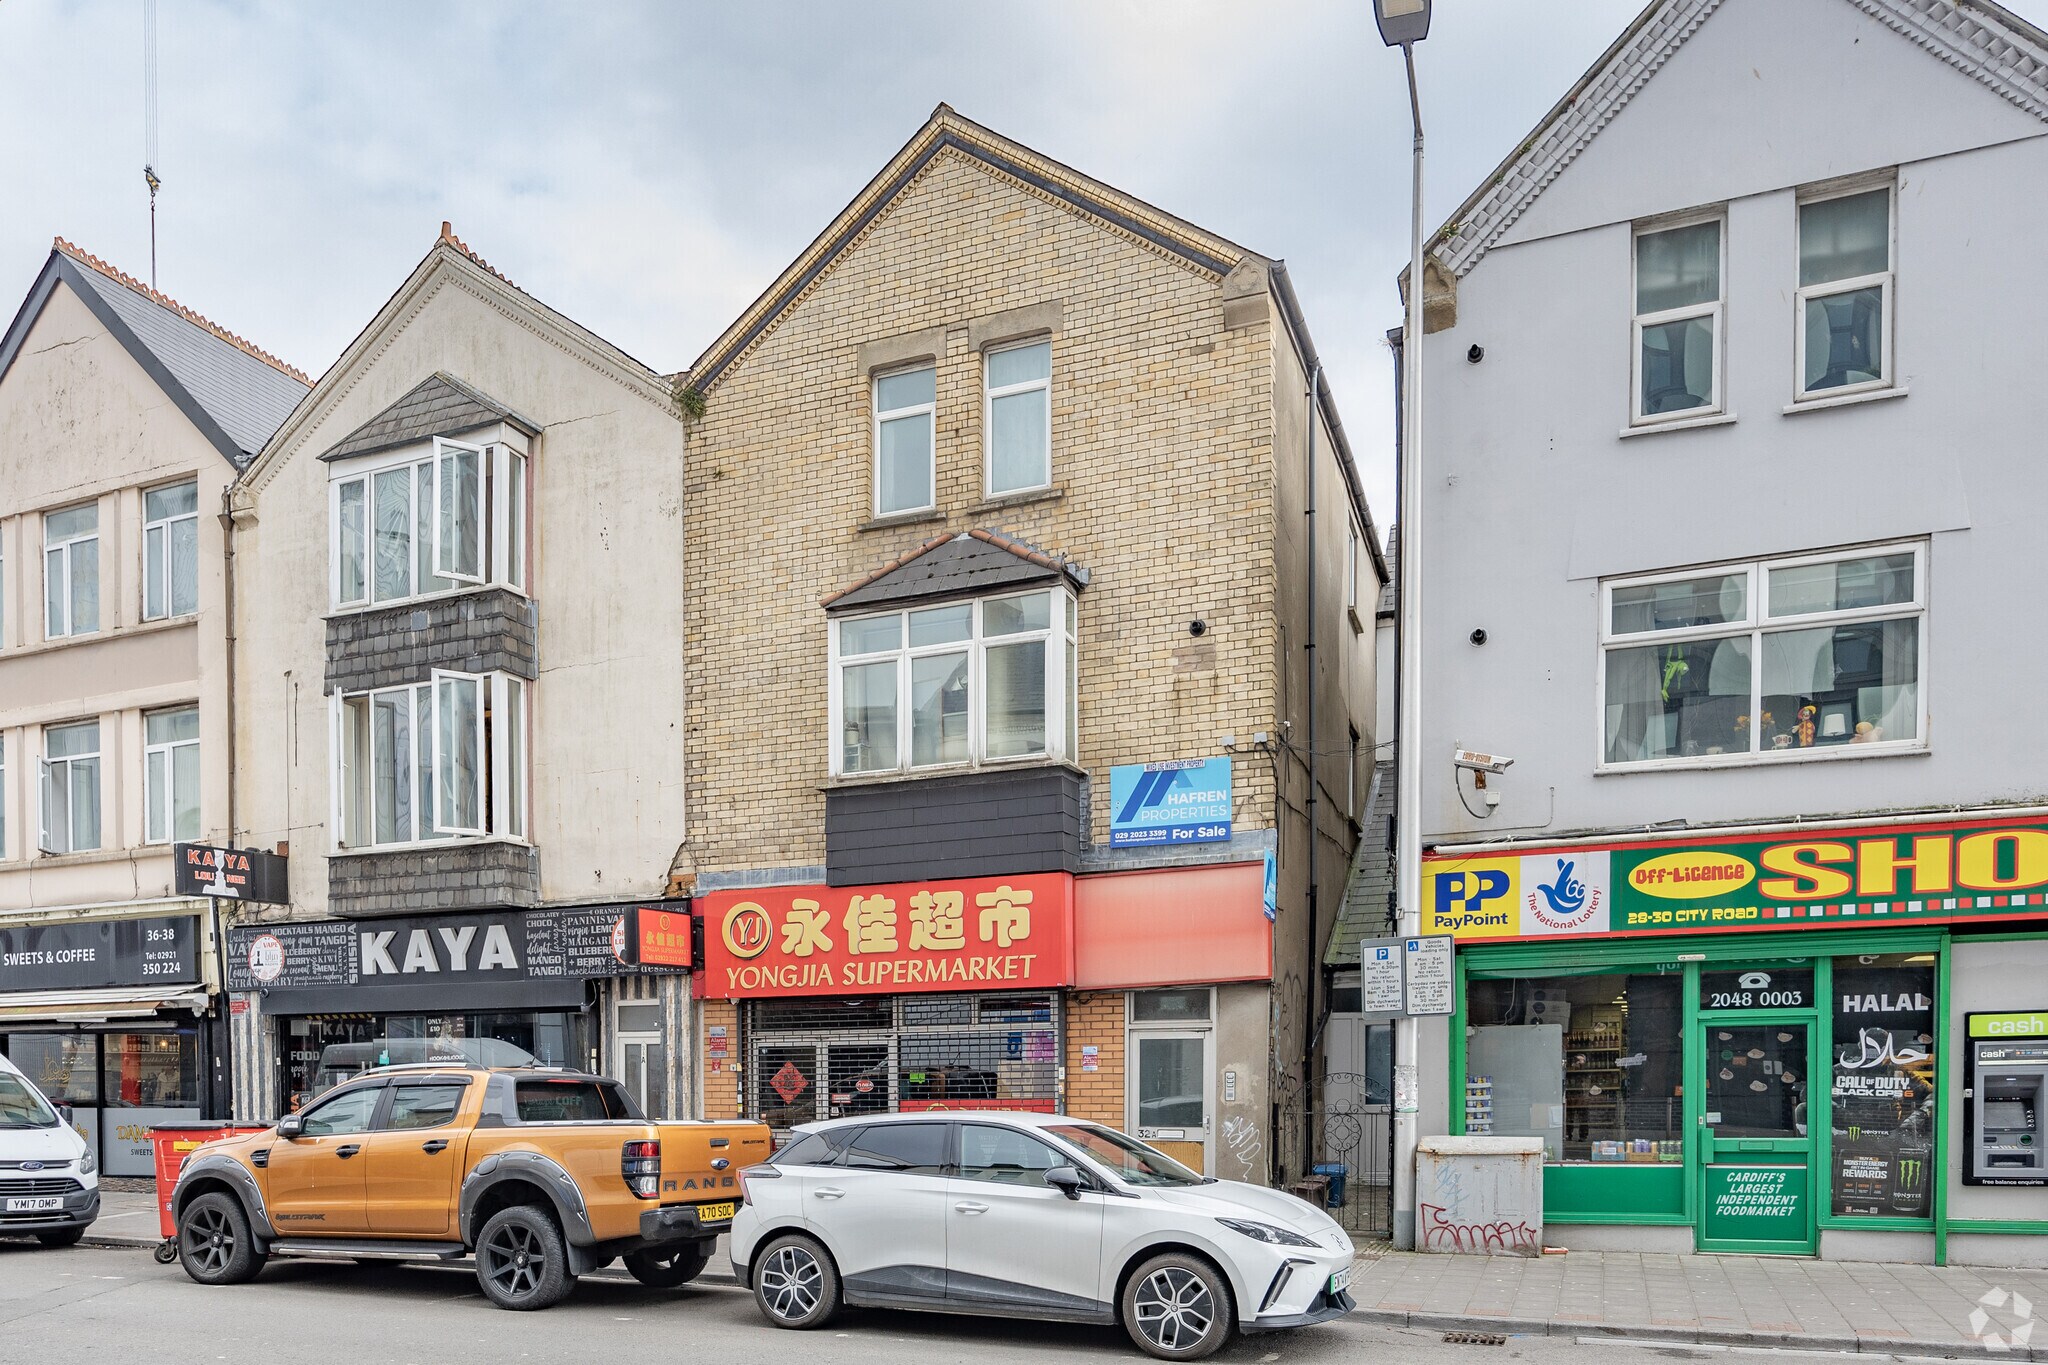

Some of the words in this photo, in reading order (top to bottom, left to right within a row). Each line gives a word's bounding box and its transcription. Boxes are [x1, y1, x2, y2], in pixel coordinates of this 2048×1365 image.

[1167, 790, 1227, 805] HAFREN
[1141, 805, 1227, 821] PROPERTIES
[1130, 830, 1148, 838] 2023
[1149, 829, 1167, 837] 3399
[1172, 829, 1194, 840] For
[1198, 826, 1226, 838] Sale
[1635, 864, 1745, 884] Off-Licence
[525, 911, 560, 919] CHOCOLATEY
[1527, 892, 1537, 911] The
[1533, 908, 1578, 929] National
[1578, 889, 1602, 924] Lottery
[526, 919, 552, 928] CHOCO
[567, 916, 606, 925] PANINIS
[780, 885, 1034, 957] 永佳超市
[1434, 912, 1508, 930] PayPoint
[1627, 911, 1673, 924] 28-30
[1675, 909, 1709, 922] CITY
[147, 928, 175, 941] 36-38
[270, 925, 313, 937] MOCKTAILS
[314, 924, 346, 935] MANGO
[567, 926, 590, 939] virgin
[314, 935, 347, 946] TANGO
[146, 952, 156, 960] Tel:
[157, 951, 177, 959] 02921
[284, 947, 322, 956] LUEBERRY
[348, 923, 359, 984] SHISHA
[361, 924, 518, 976] KAYA
[526, 942, 551, 957] delight
[1380, 950, 1386, 959] P
[3, 951, 43, 966] SWEETS
[46, 951, 54, 964] &
[56, 948, 95, 963] COFFEE
[286, 957, 311, 965] BERRY
[318, 955, 338, 963] KIWI
[527, 955, 562, 965] MANGO
[142, 963, 160, 975] 350
[163, 962, 181, 974] 224
[318, 964, 338, 972] MENU
[527, 966, 562, 976] TANGO
[576, 957, 607, 966] BERRY
[726, 962, 834, 990] YONGJIA
[842, 954, 1037, 986] SUPERMARKET
[1711, 992, 1752, 1007] 2048
[1760, 991, 1802, 1006] 0003
[1843, 993, 1929, 1012] HALAL
[323, 1023, 366, 1035] KAYA
[1988, 1016, 2044, 1034] cash
[1840, 1027, 1930, 1069] حلال
[1980, 1050, 2005, 1058] cash
[290, 1051, 320, 1061] FOOD
[1836, 1076, 1867, 1088] CALL
[1875, 1077, 1910, 1090] DUTY
[1832, 1088, 1874, 1096] BLACK
[1904, 1090, 1914, 1098] 6
[1727, 1172, 1786, 1182] CARDIFF'S
[1842, 1169, 1887, 1179] REWARDS
[663, 1177, 734, 1191] RANG
[1729, 1184, 1784, 1194] LARGEST
[14, 1200, 36, 1209] YM17
[39, 1199, 57, 1208] OMP
[1716, 1195, 1798, 1205] INDEPENDENT
[699, 1206, 716, 1219] A70
[1716, 1206, 1796, 1216] FOODMARKET
